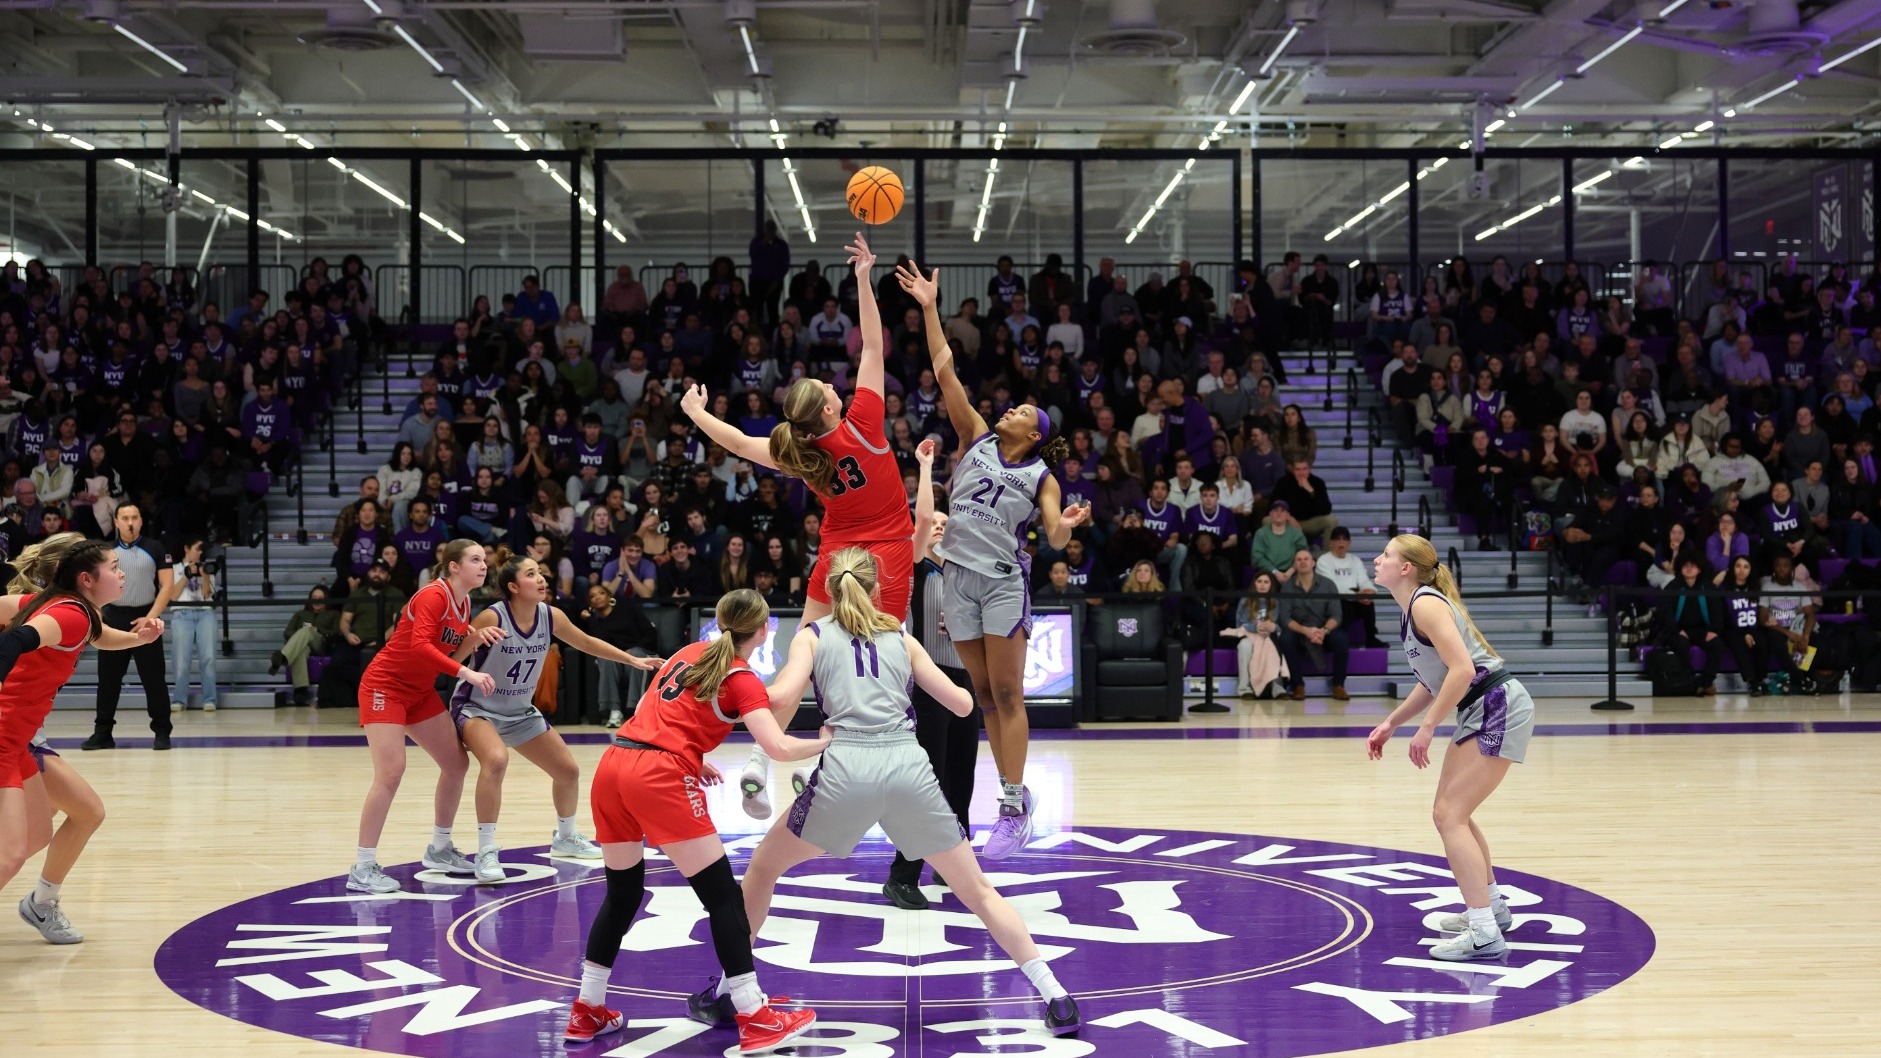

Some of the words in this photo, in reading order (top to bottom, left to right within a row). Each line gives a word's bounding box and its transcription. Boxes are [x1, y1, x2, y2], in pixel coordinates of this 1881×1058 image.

[104, 371, 125, 381] NYU
[285, 376, 306, 389] NYU
[256, 414, 276, 424] NYU
[22, 431, 44, 443] NYU
[255, 425, 272, 437] 26
[60, 452, 79, 462] YU
[580, 454, 603, 465] NYU
[970, 476, 1006, 509] 21
[1143, 519, 1168, 531] NYU
[1773, 518, 1799, 532] NYU
[405, 540, 431, 550] NYU
[1334, 569, 1353, 577] NYU
[1737, 610, 1757, 627] 26
[441, 626, 465, 646] Was
[500, 645, 524, 655] NEW
[526, 643, 547, 654] YORK
[850, 636, 880, 679] 11
[506, 658, 537, 685] 47
[372, 688, 386, 711] ARS
[215, 923, 572, 1037] NEW
